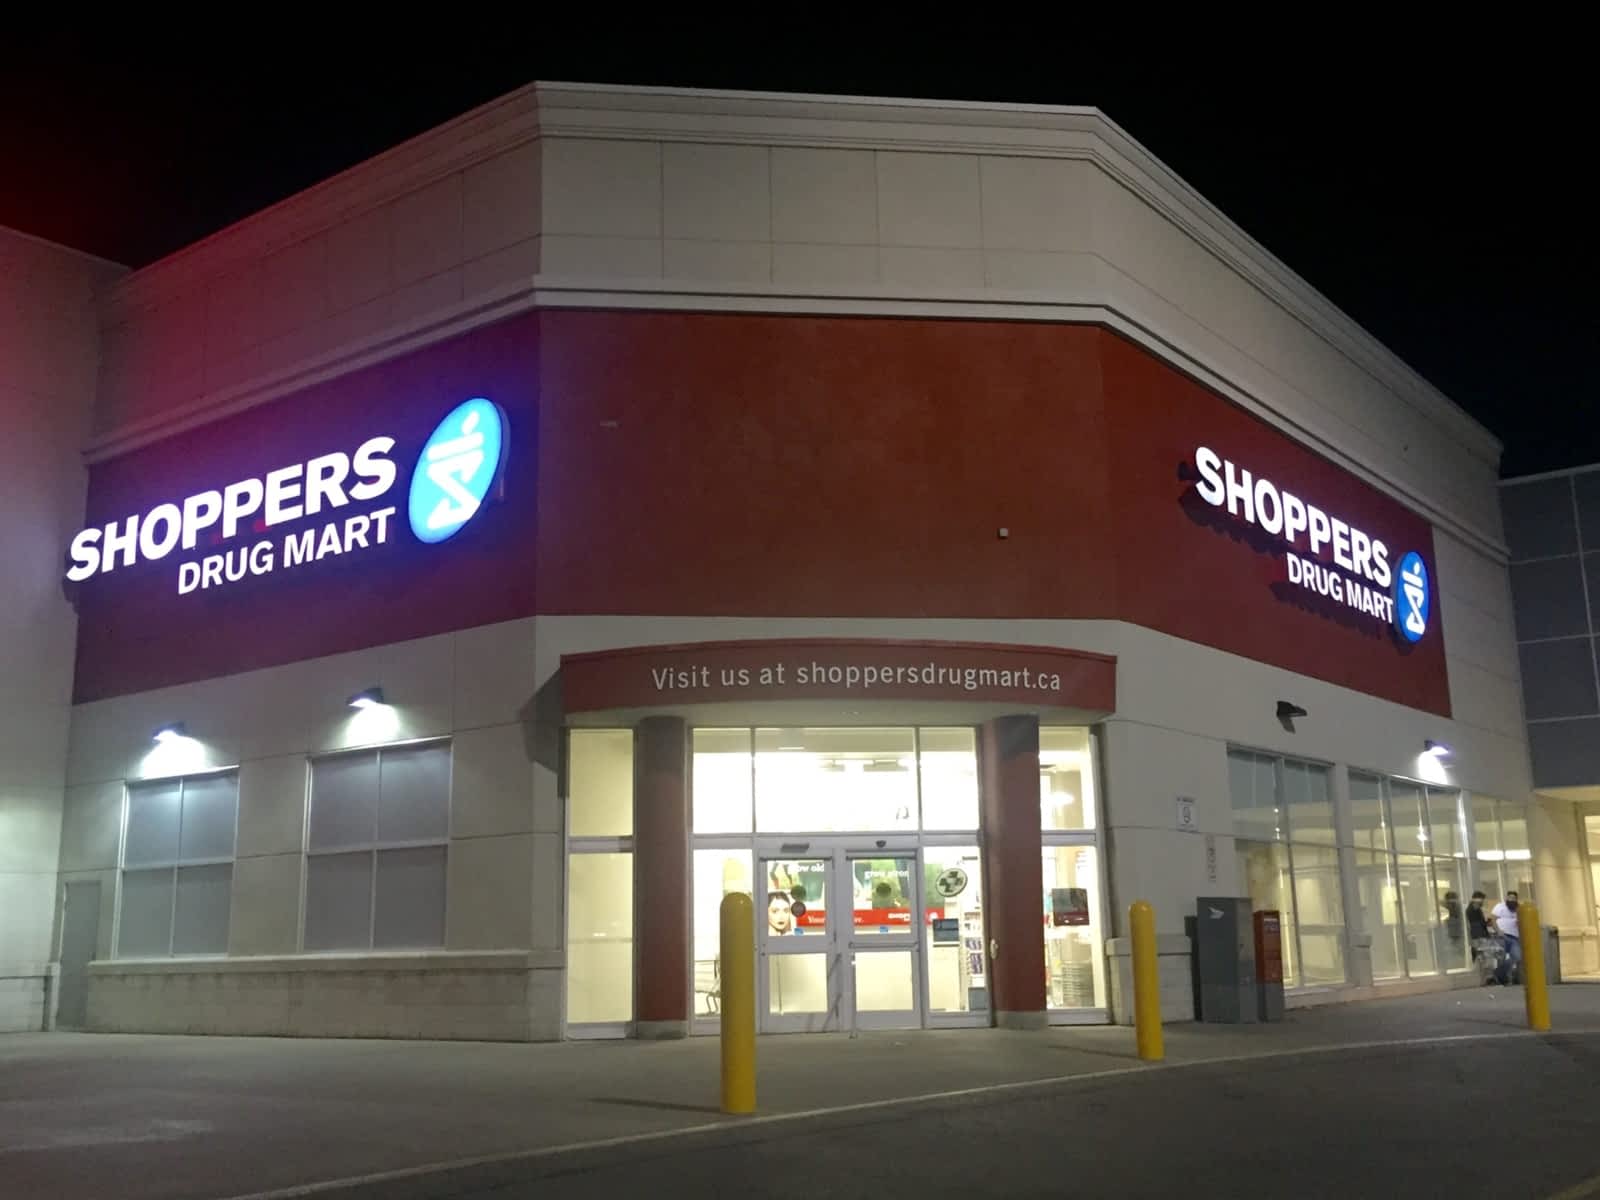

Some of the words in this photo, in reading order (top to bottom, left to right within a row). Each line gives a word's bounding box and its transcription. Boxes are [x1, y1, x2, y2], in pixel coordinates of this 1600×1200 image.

[66, 436, 397, 581] SHOPPERS
[178, 540, 275, 595] DRUG
[283, 506, 396, 568] MART
[1195, 446, 1392, 588] SHOPPERS
[1286, 552, 1344, 602] DRUG
[1345, 578, 1394, 624] MART
[651, 665, 711, 691] Visit
[720, 669, 750, 687] us
[759, 663, 785, 686] at
[796, 661, 1062, 692] shoppersdrugmart.ca
